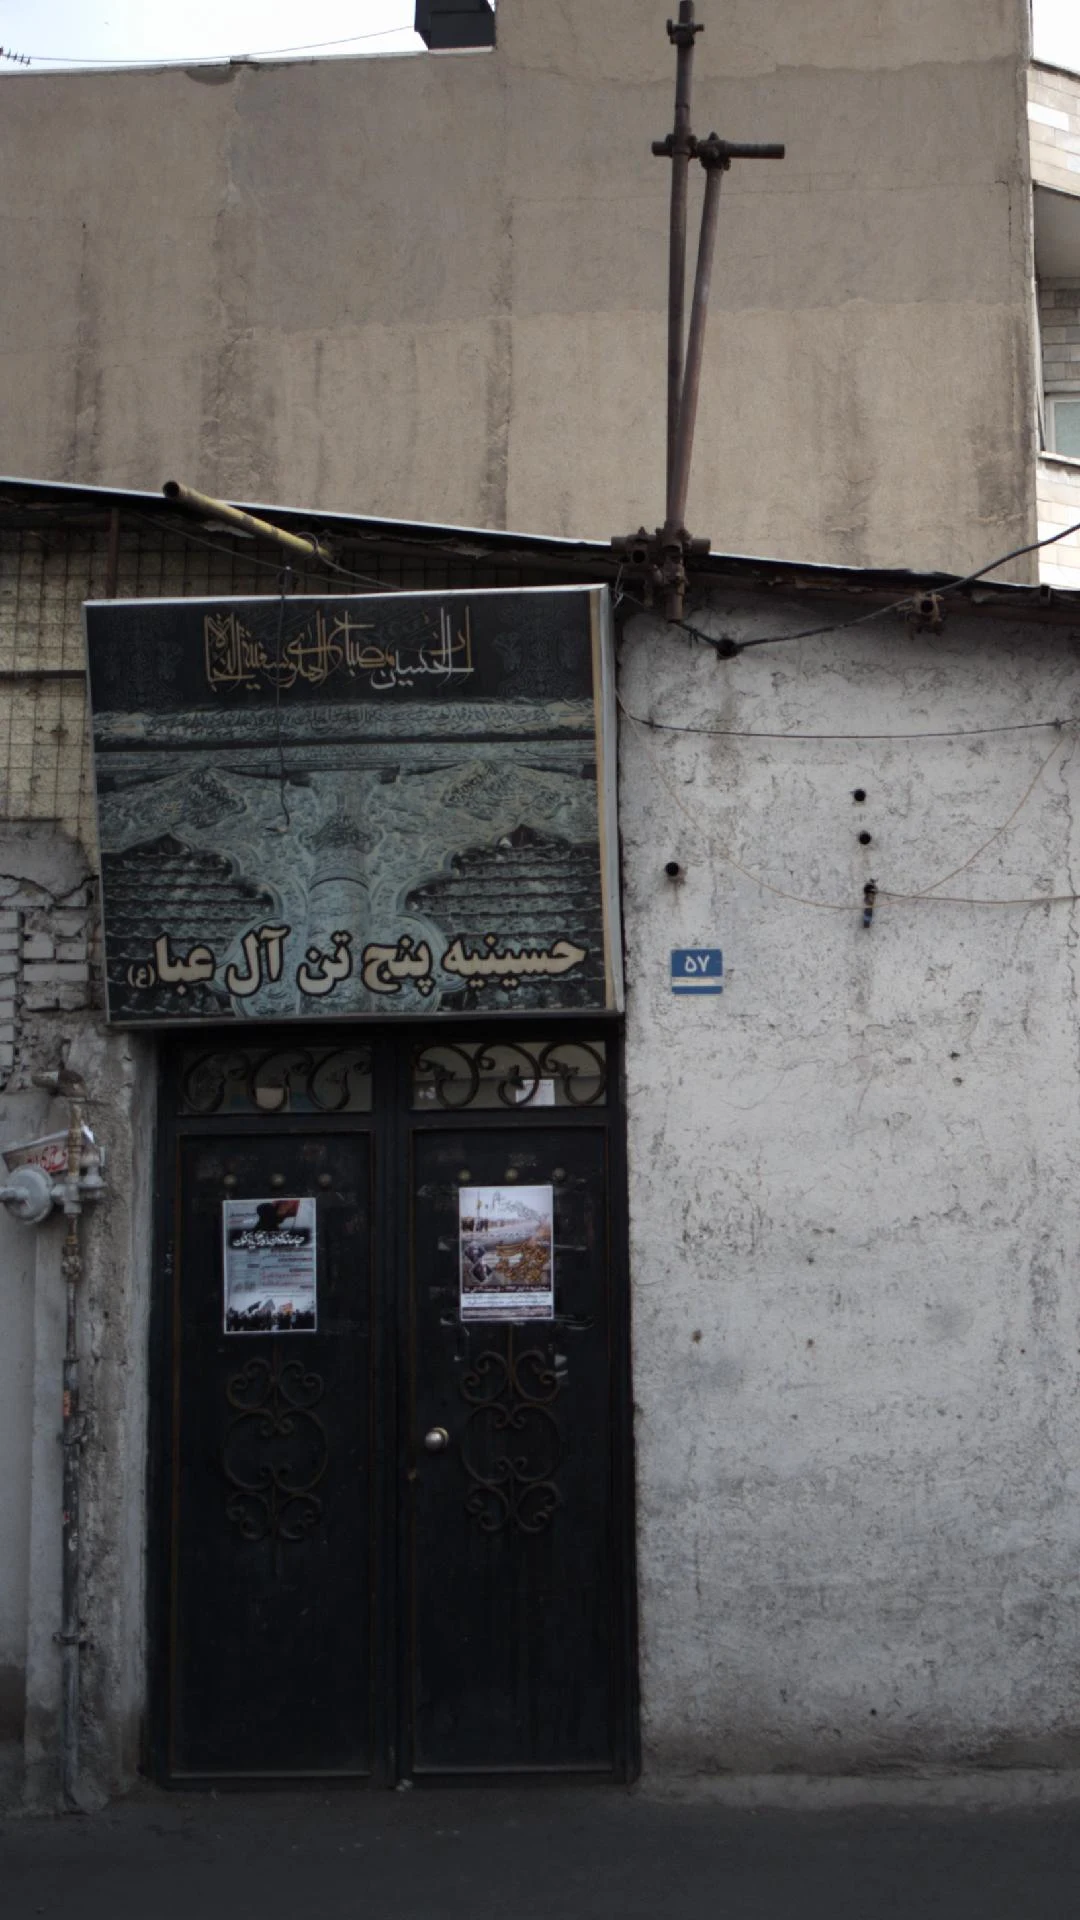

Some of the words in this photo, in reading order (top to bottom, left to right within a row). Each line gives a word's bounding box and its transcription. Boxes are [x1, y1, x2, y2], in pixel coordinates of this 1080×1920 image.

[154, 933, 216, 995] عبا
[226, 924, 291, 997] آل
[296, 930, 353, 996] تن
[361, 934, 432, 995] پنج
[442, 934, 587, 989] حسینیه
[684, 954, 710, 973] ۵۷
